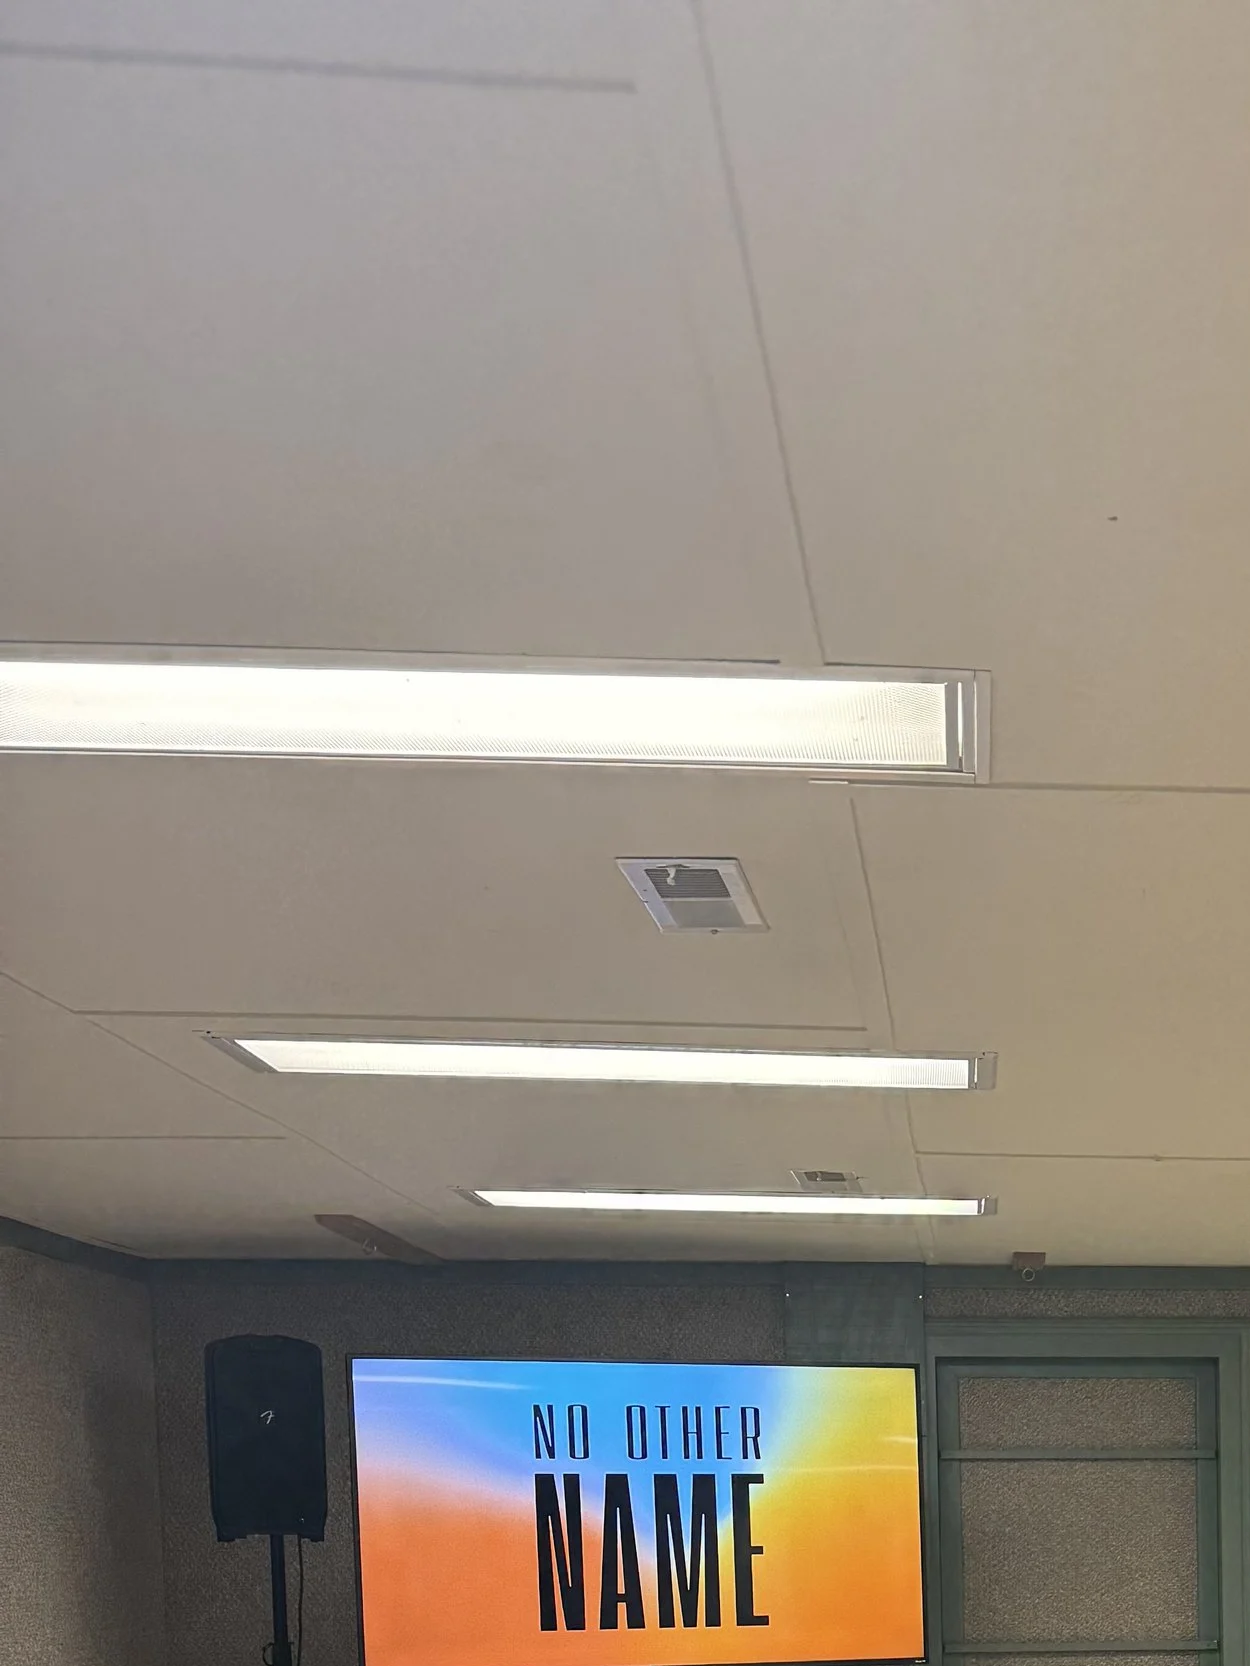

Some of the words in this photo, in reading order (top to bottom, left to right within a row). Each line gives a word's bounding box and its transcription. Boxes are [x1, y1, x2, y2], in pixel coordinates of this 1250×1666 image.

[533, 1404, 590, 1460] NO
[625, 1404, 762, 1460] OTHER
[534, 1473, 770, 1632] NAME
